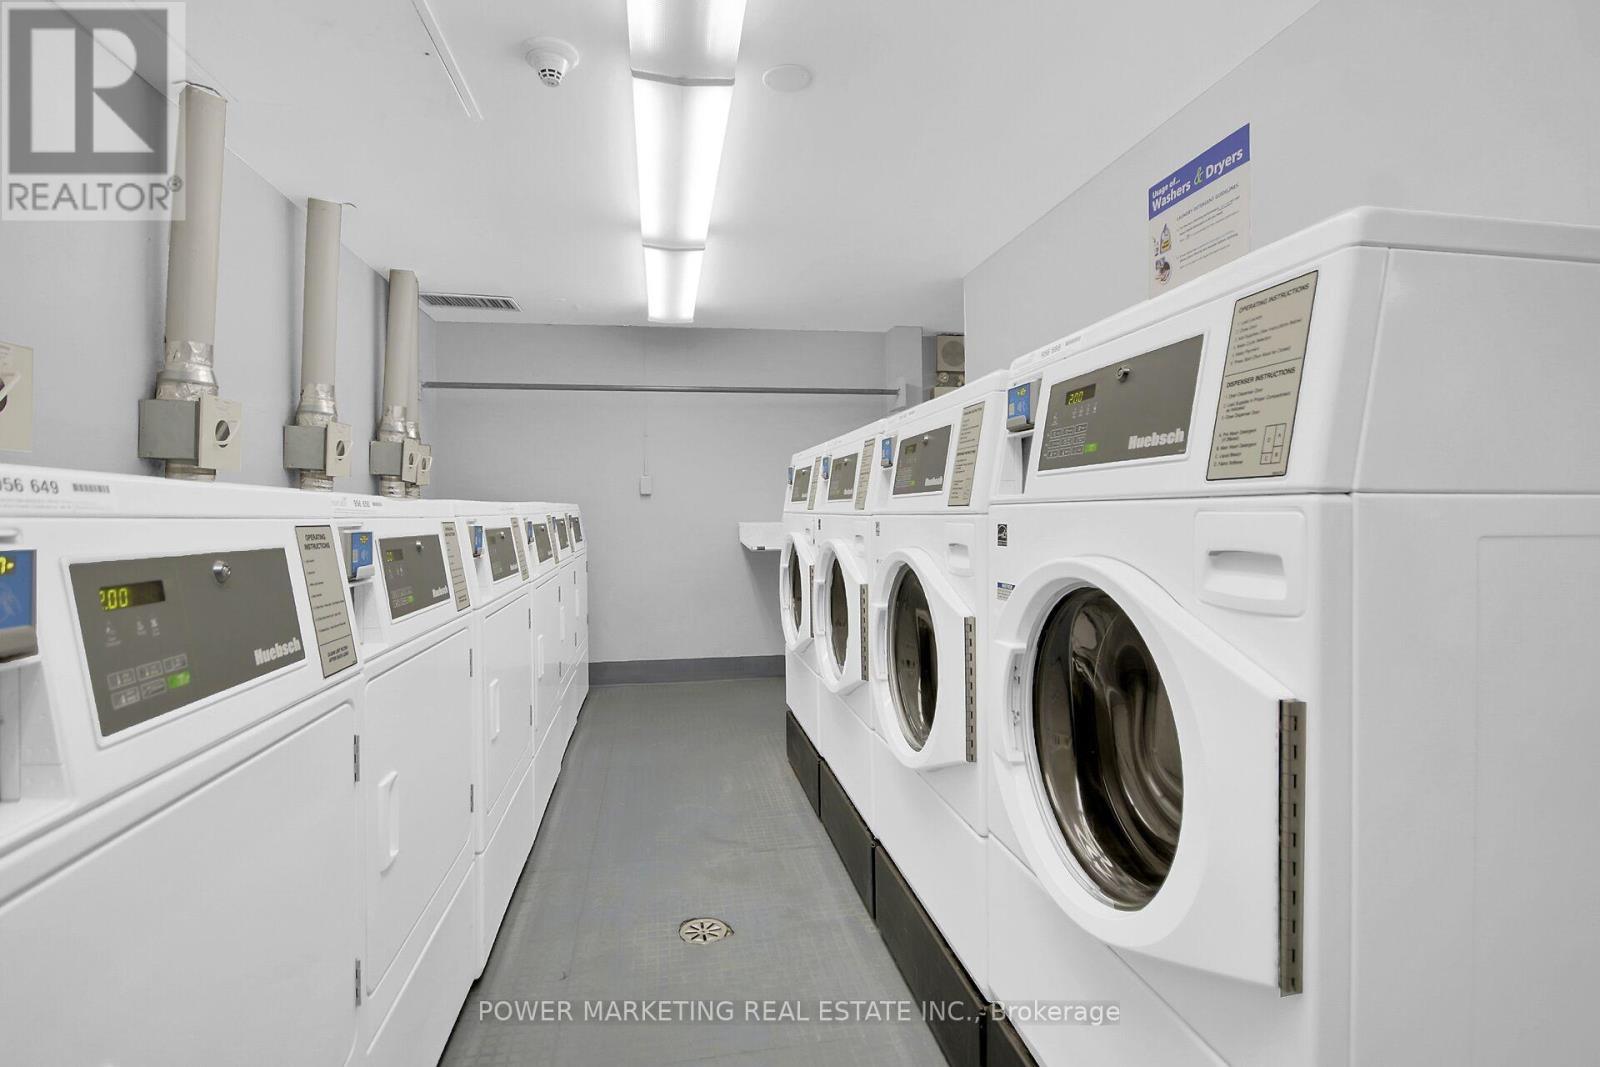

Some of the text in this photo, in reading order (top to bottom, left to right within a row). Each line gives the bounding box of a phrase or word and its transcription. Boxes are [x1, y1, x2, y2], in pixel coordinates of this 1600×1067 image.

[1152, 148, 1243, 211] Washers & Dryers
[1152, 184, 1169, 198] Usage
[1268, 282, 1311, 302] INSTRUCTIONS
[1226, 366, 1297, 388] DISPENSER INSTRUCTIONS
[1127, 427, 1185, 450] Huebsch
[30, 478, 60, 494] 649
[253, 636, 302, 666] Huebsch
